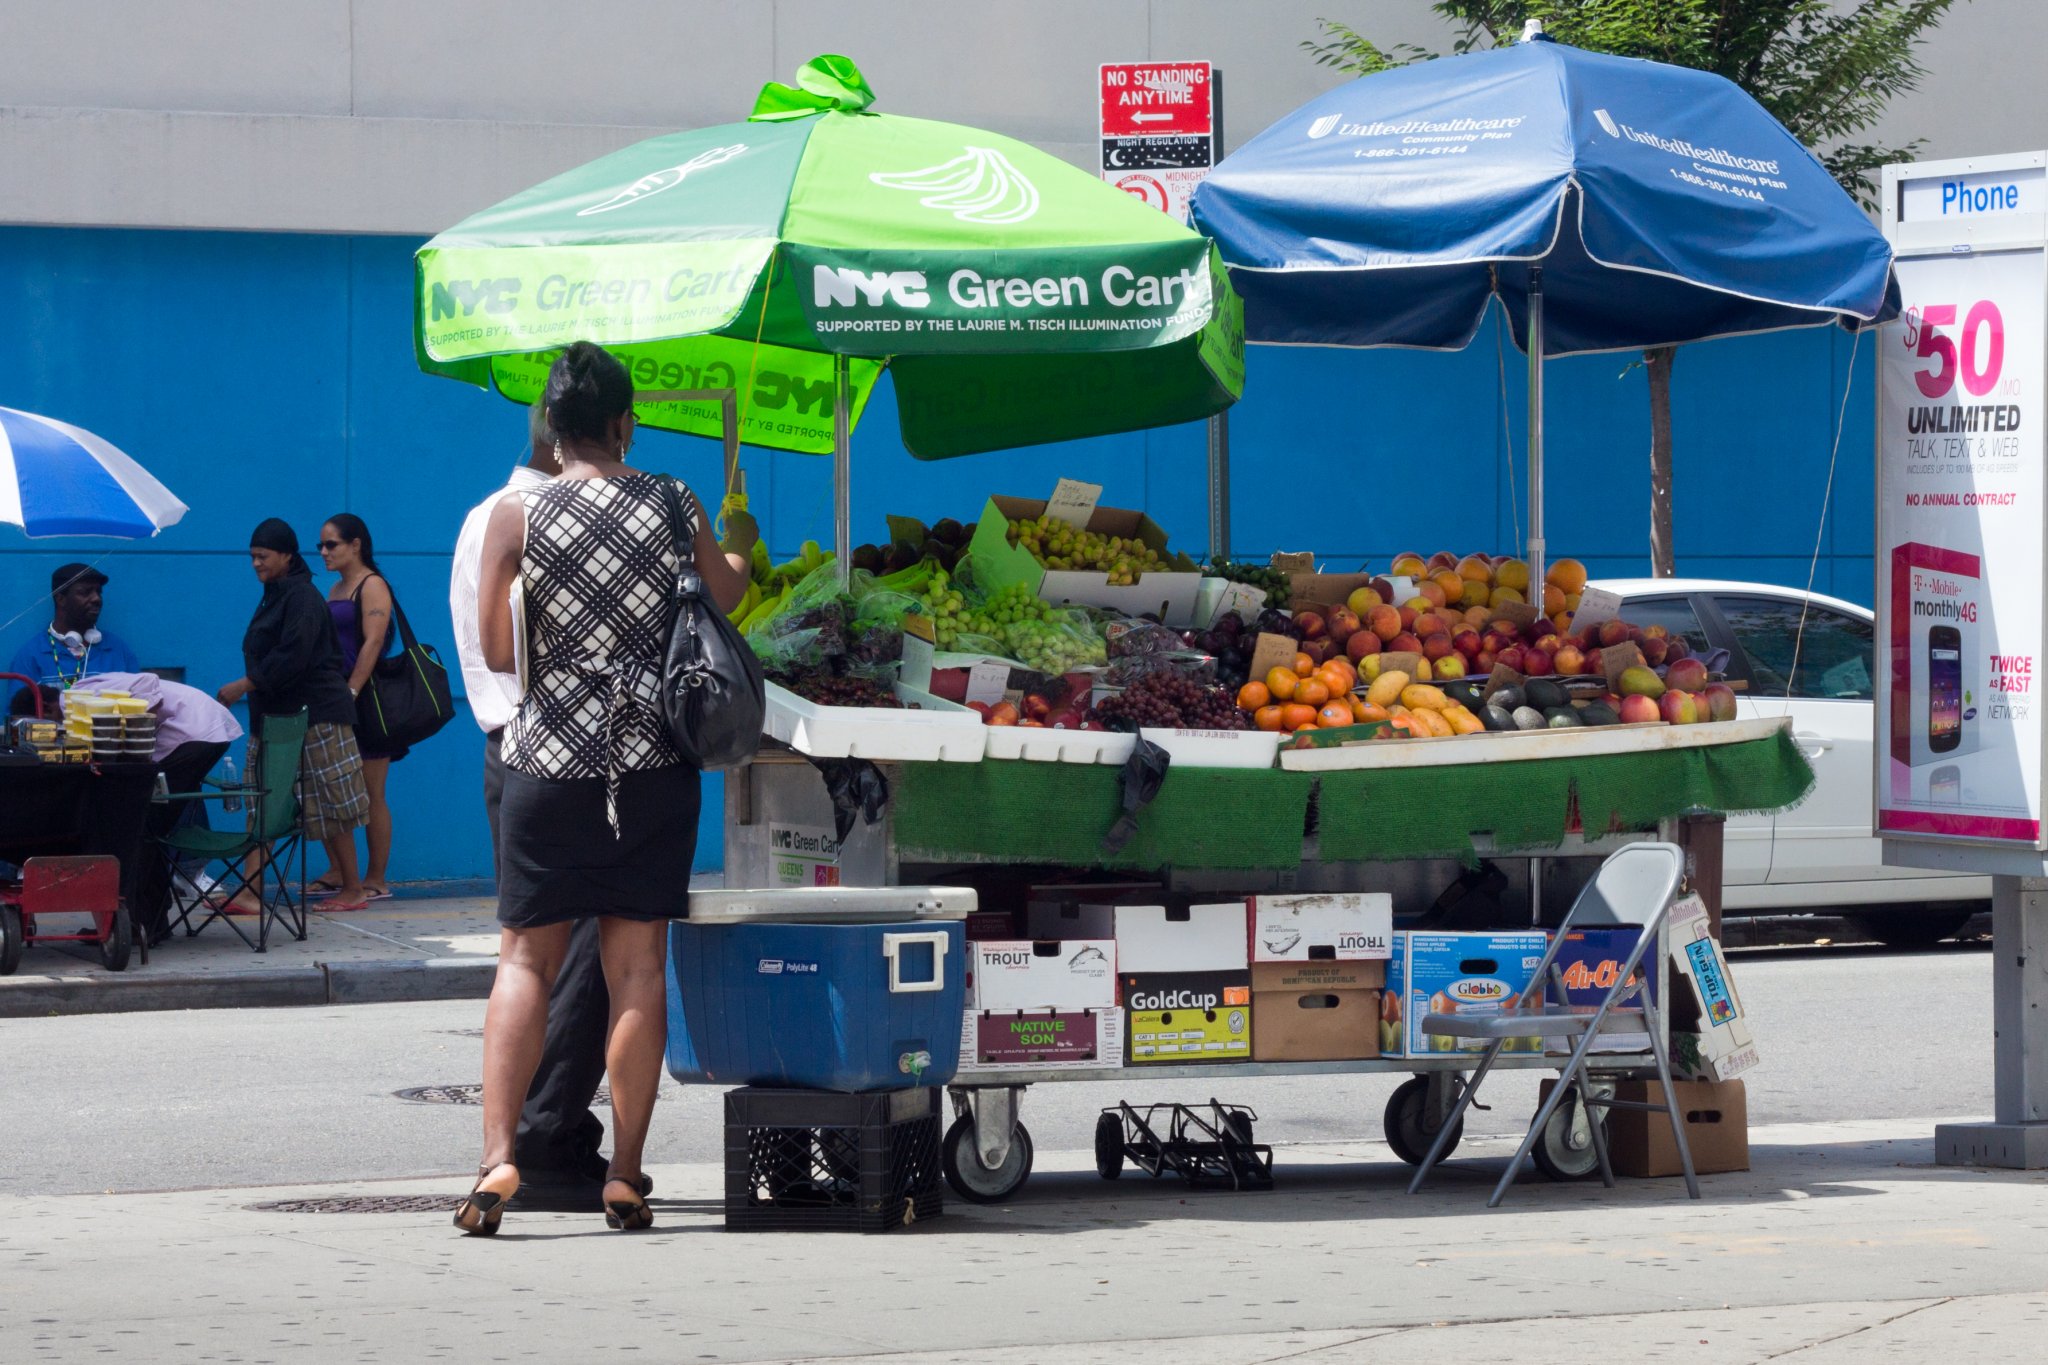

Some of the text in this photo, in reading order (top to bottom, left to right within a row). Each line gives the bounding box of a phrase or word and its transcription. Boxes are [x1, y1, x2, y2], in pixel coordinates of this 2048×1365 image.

[1107, 69, 1204, 86] NO STANDING
[1119, 90, 1193, 106] ANYTIME
[1338, 116, 1523, 136] UnitedHealthcare
[1117, 137, 1199, 147] NIGHT REGULATION
[1402, 131, 1513, 143] Community Plan
[1353, 145, 1468, 158] 1-866-301-6144
[1620, 124, 1780, 175] UnitedHealthcare
[1166, 170, 1207, 182] MIDNIGHT
[1692, 162, 1787, 190] Community Plan
[1669, 168, 1764, 202] 1-866-301-6144
[1943, 182, 2019, 214] Phone
[432, 264, 745, 322] NYC Green Cart
[814, 265, 1201, 308] NYC Green Cart
[430, 327, 482, 346] SUPPORTED
[486, 326, 500, 337] BY
[529, 321, 566, 335] LAURIE
[700, 304, 732, 316] FUND
[816, 307, 1205, 332] SUPPORTED BY THE LAURIE M. TISCH ILLUMINATION FUND
[1907, 404, 2021, 434] UNLIMITED
[1907, 437, 2019, 461] TALK, TEXT & WEB
[1905, 492, 2017, 506] NO ANNUAL CONTRACT
[1989, 655, 2033, 673] TWICE
[1989, 675, 2032, 692] AS FAST
[1989, 694, 1997, 703] AS
[1988, 705, 2029, 721] NETWORK
[771, 829, 791, 848] NYC
[793, 831, 819, 851] Green
[778, 861, 804, 877] QUEENS
[1338, 936, 1386, 949] TROUT
[810, 963, 818, 972] 48
[983, 953, 1030, 965] TROUT
[1693, 944, 1719, 1000] TOP GUN
[1458, 982, 1502, 994] Globbo
[1130, 989, 1217, 1012] GoldCup
[1010, 1021, 1066, 1033] NATIVE
[1020, 1034, 1055, 1045] SON
